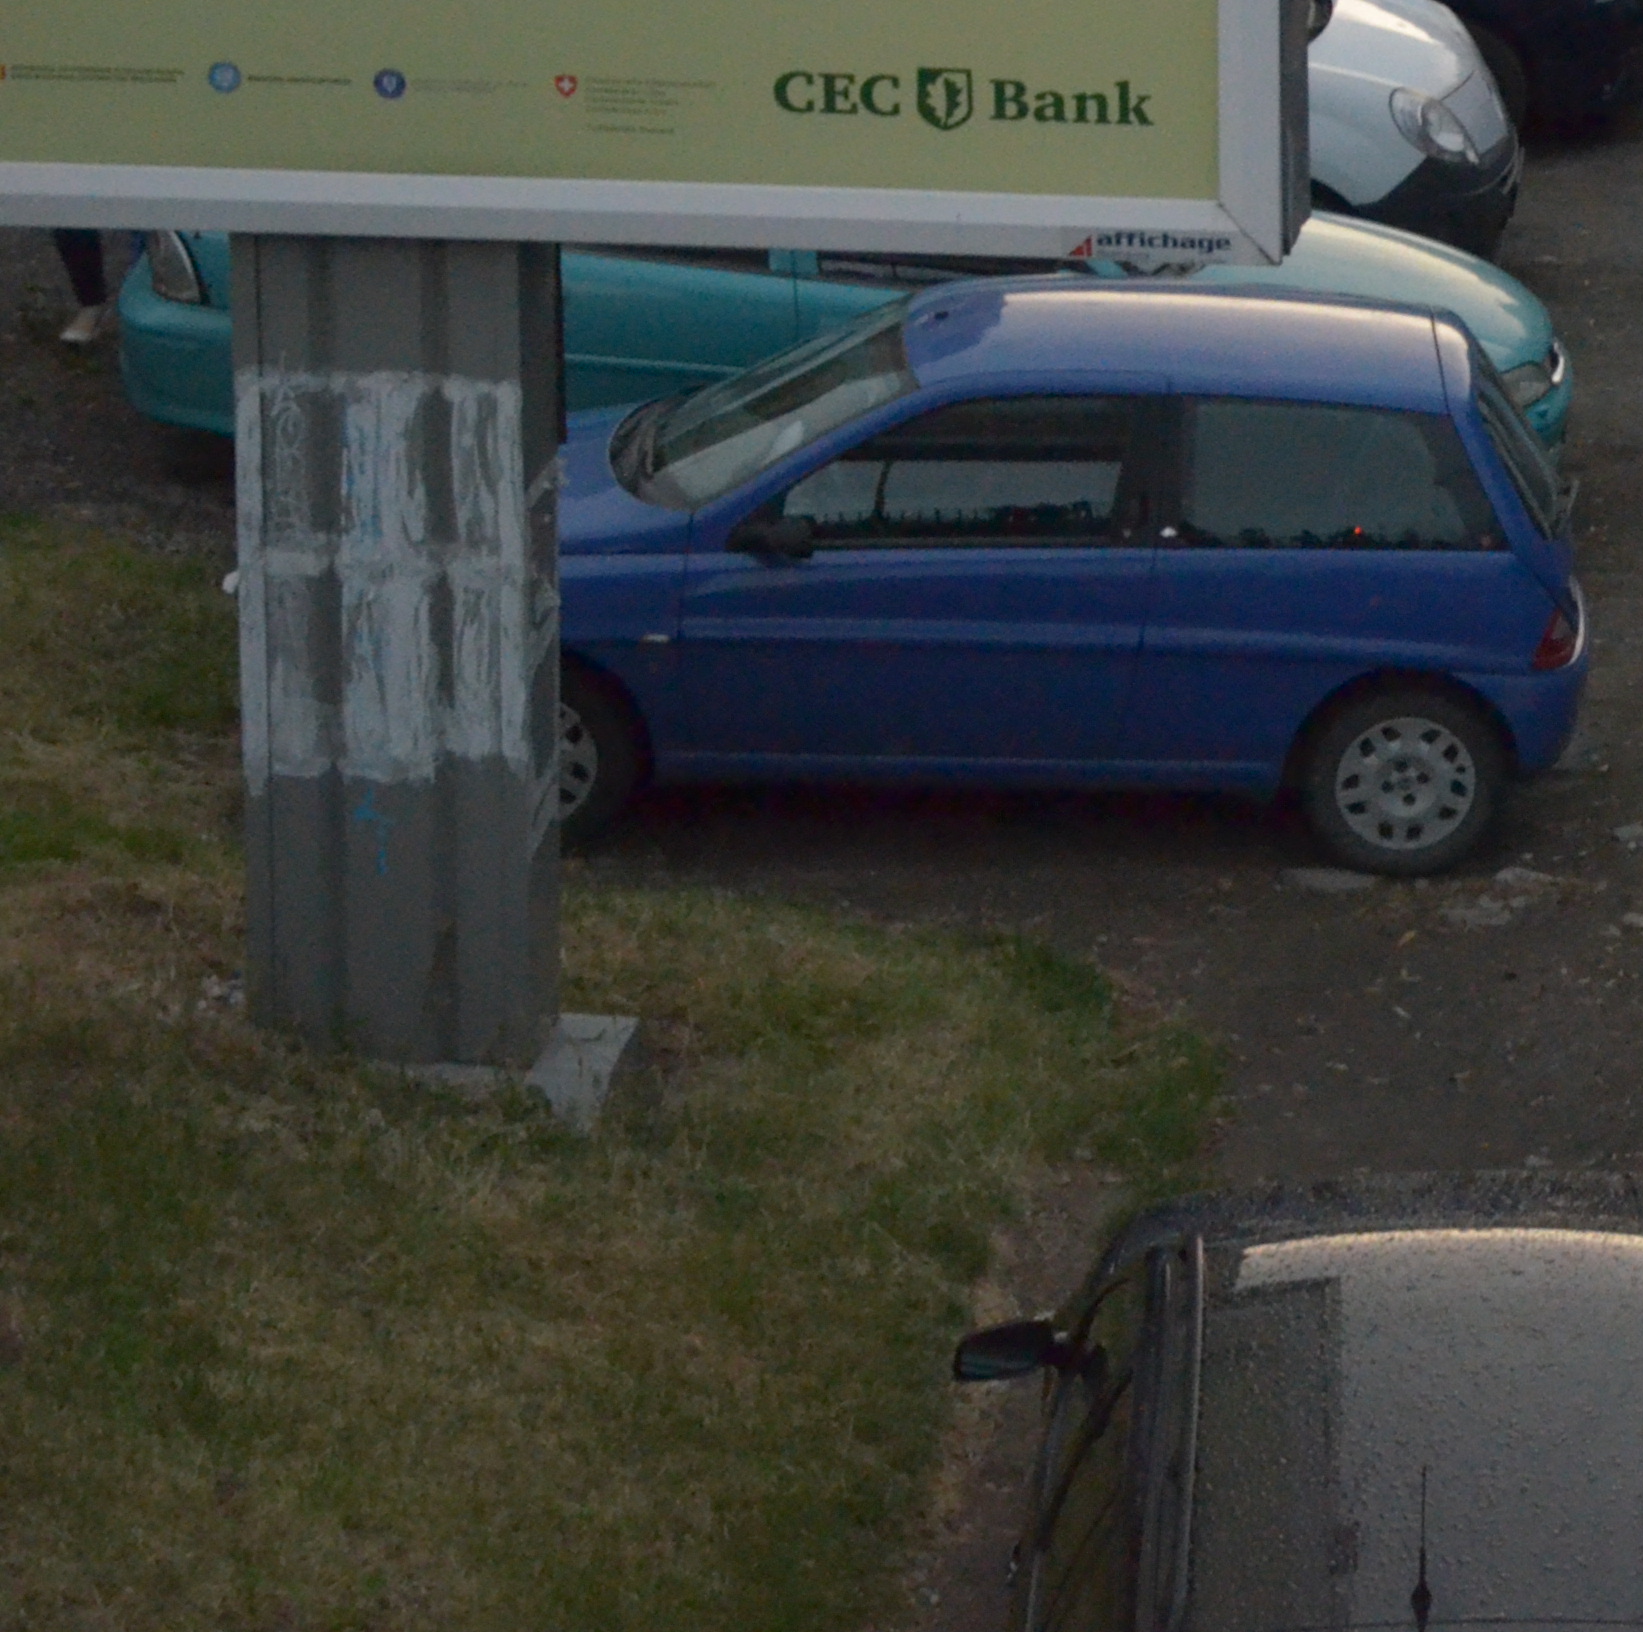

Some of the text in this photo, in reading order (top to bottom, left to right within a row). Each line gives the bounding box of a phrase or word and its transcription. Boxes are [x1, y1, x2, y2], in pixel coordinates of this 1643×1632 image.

[773, 69, 901, 118] CEC
[989, 78, 1155, 127] Bank
[1097, 231, 1232, 253] affichage
